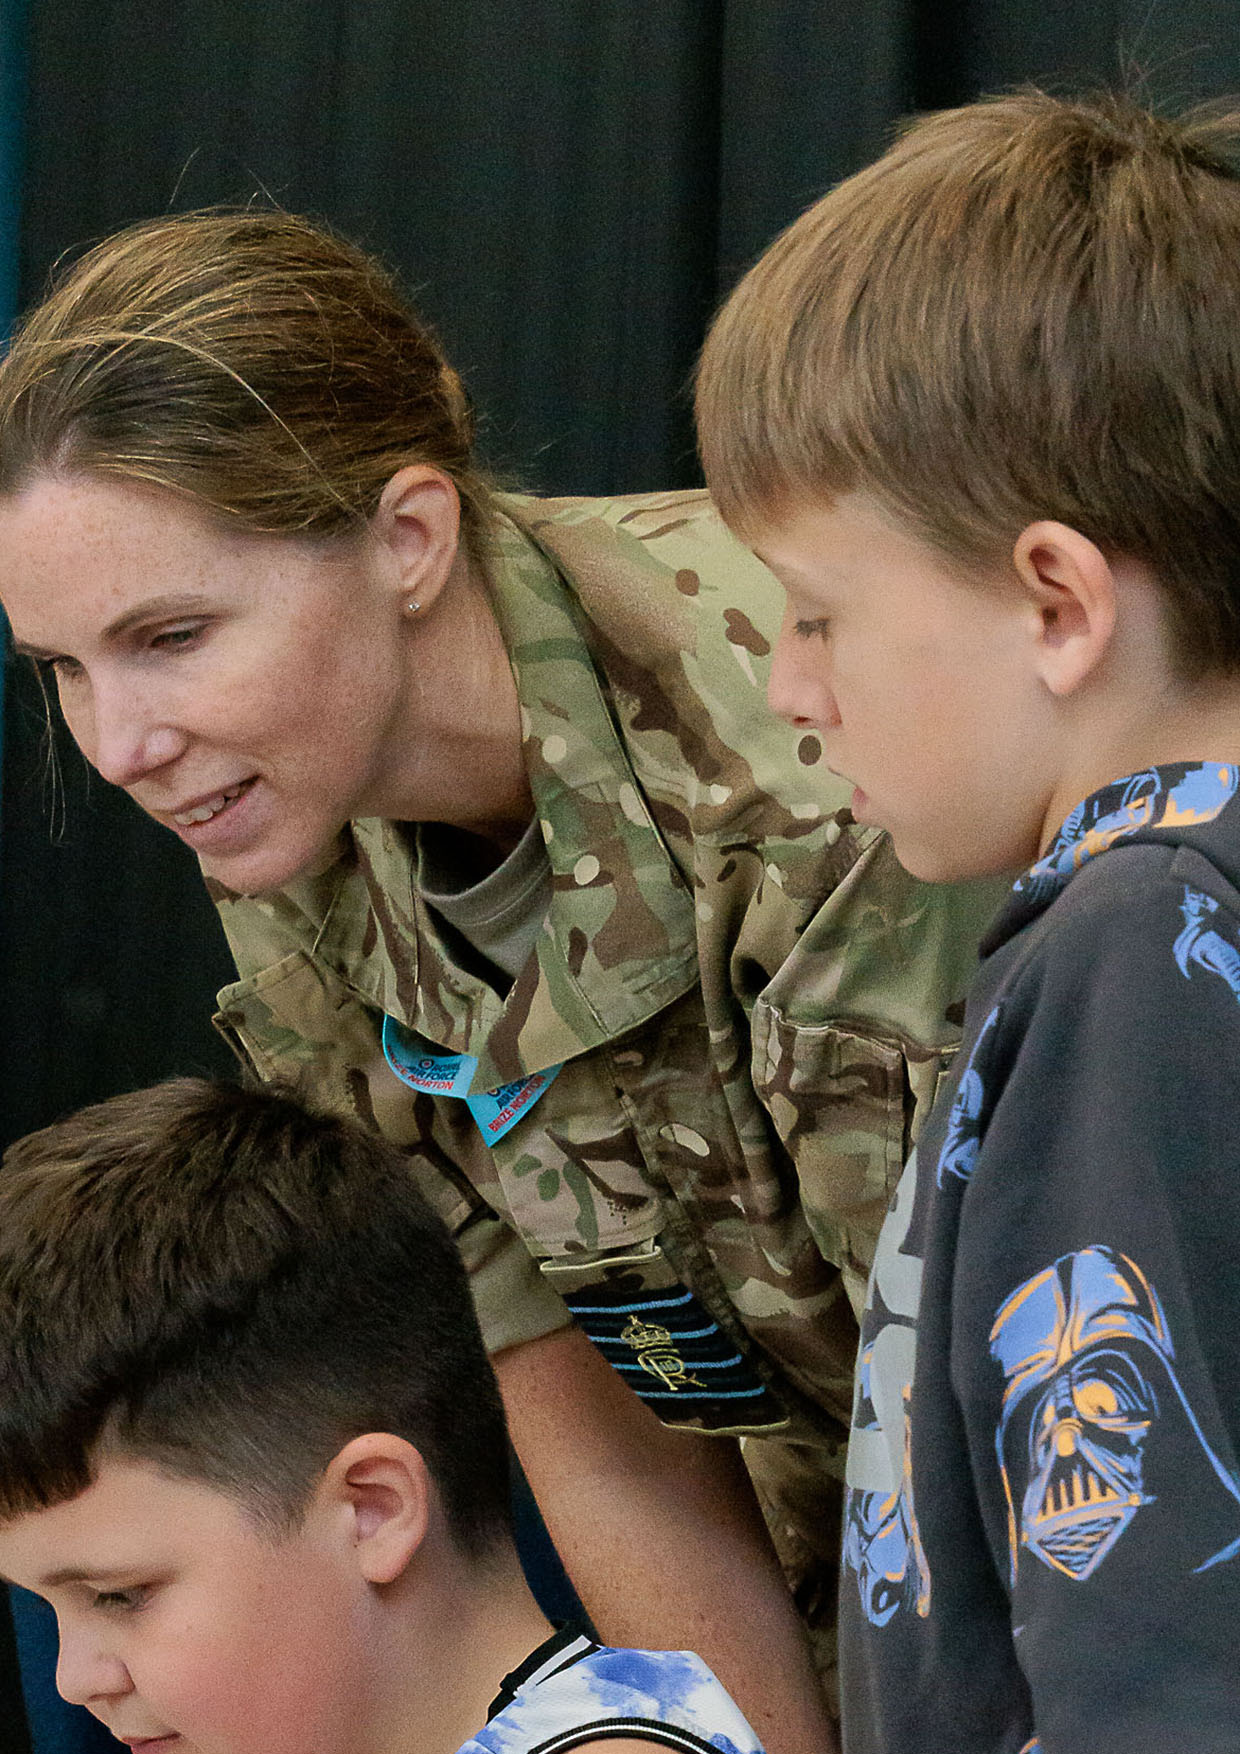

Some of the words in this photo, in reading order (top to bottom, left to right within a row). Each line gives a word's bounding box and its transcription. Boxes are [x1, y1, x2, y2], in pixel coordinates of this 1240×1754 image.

[408, 1074, 454, 1090] NORTON
[488, 1108, 515, 1133] BRIZE
[509, 1075, 547, 1111] NORTON
